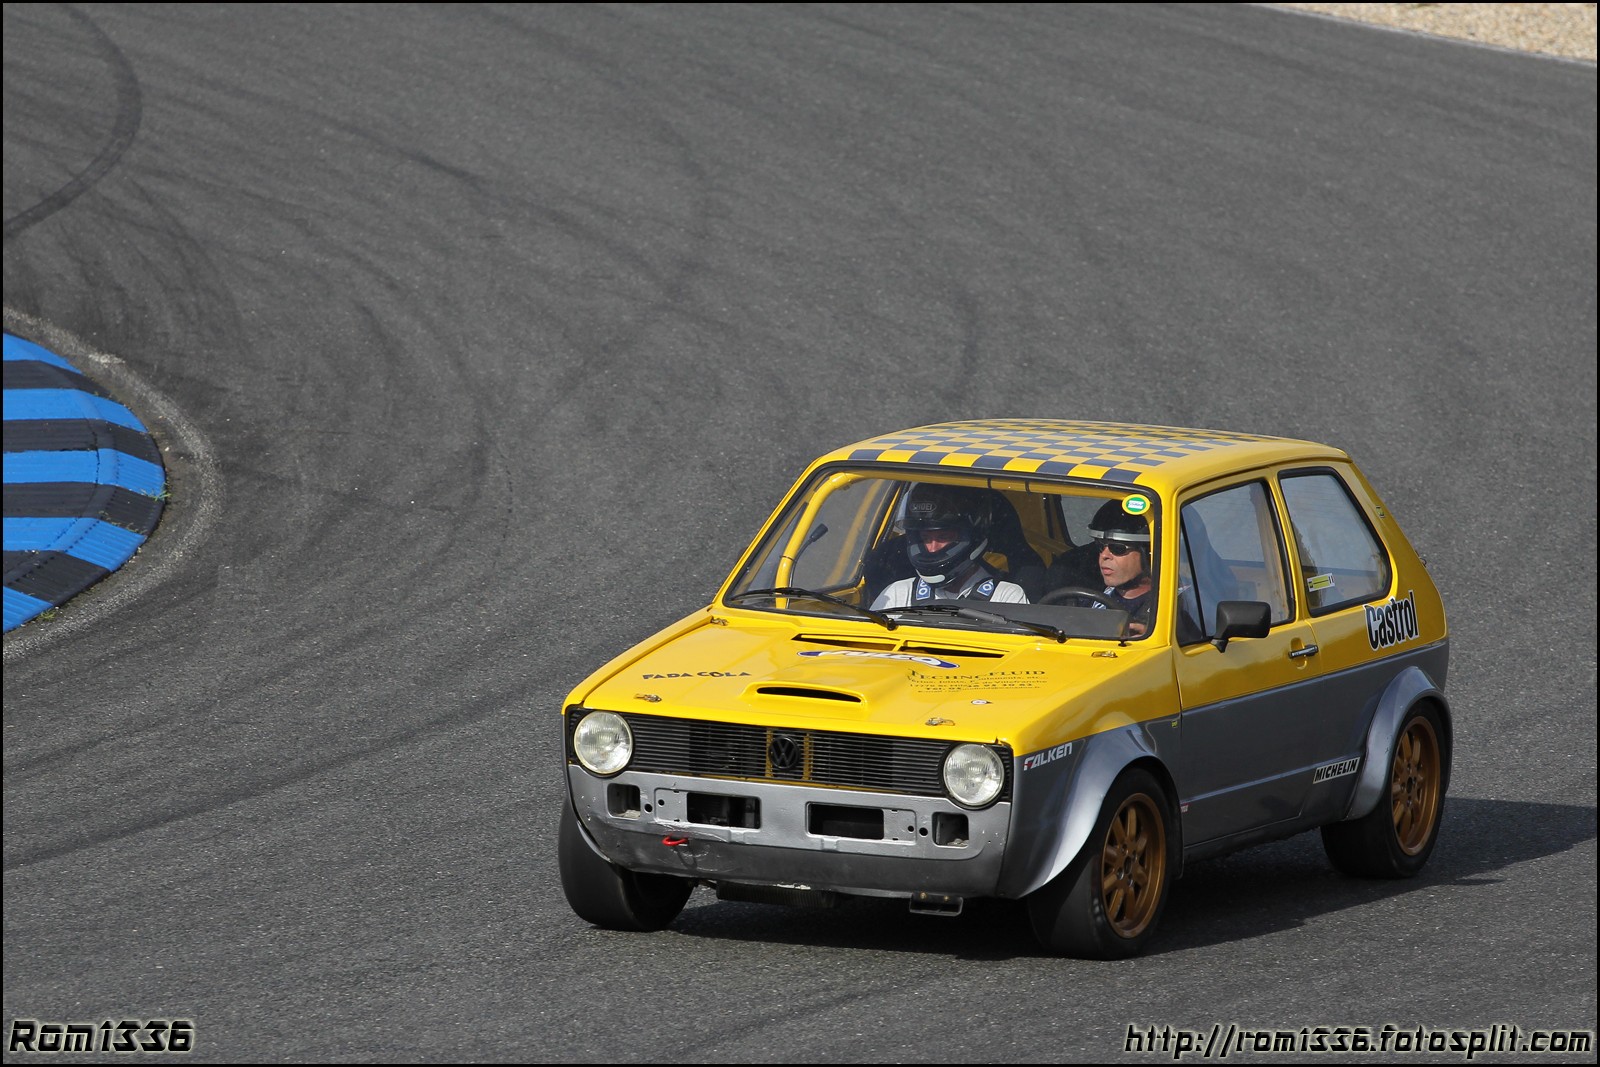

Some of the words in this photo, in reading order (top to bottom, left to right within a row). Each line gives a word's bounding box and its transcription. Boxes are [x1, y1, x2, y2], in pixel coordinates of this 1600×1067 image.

[1365, 591, 1419, 651] Castrol
[642, 672, 693, 680] FADA
[1023, 742, 1073, 771] FALKEN
[1314, 758, 1359, 783] MICHELIN
